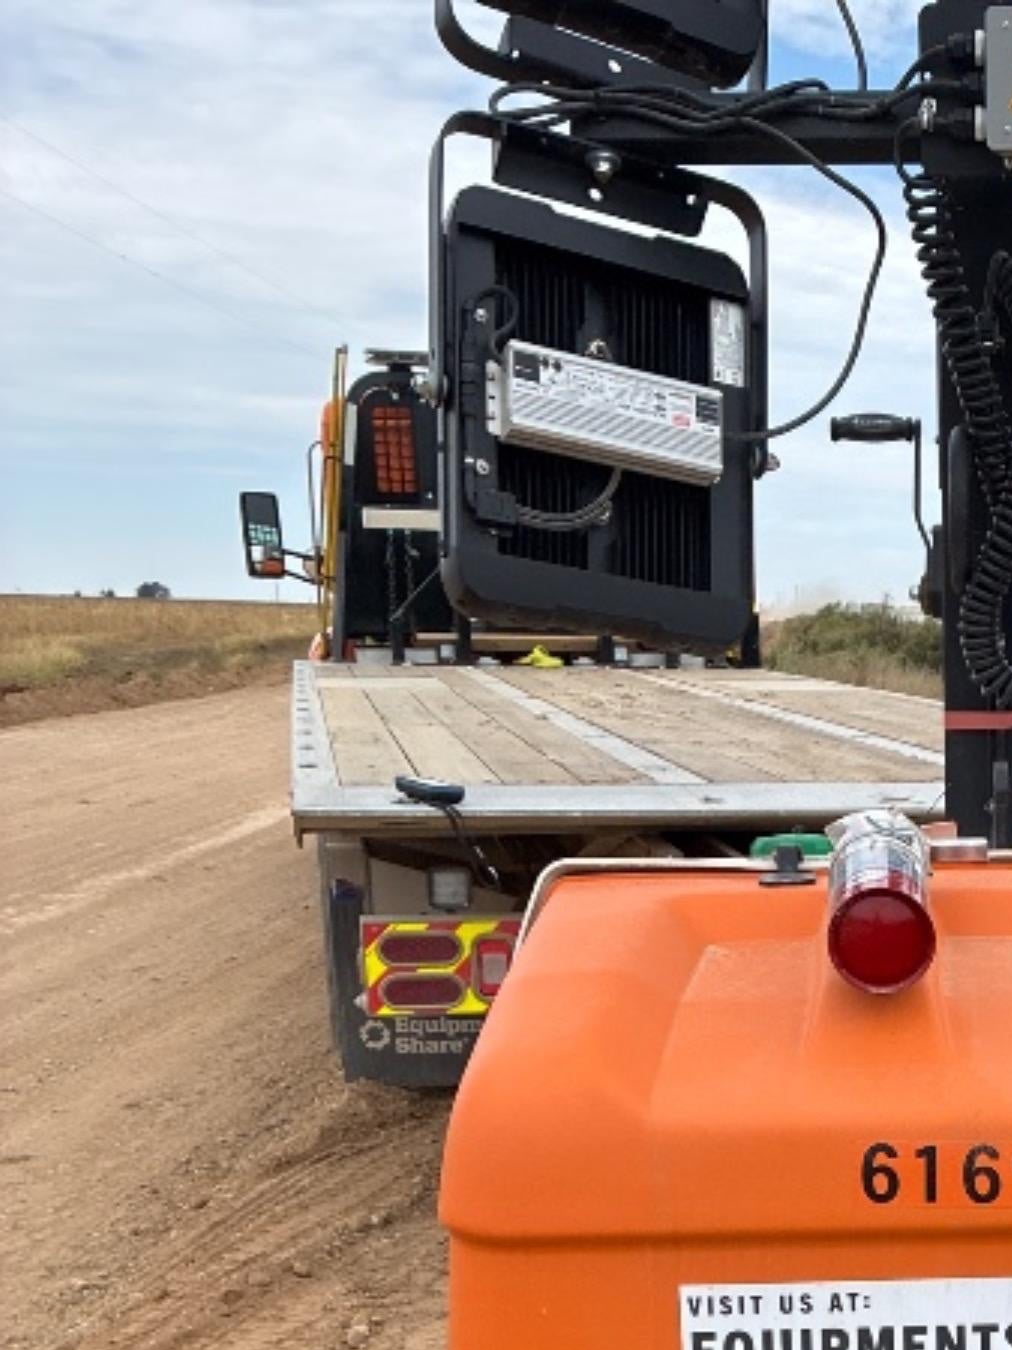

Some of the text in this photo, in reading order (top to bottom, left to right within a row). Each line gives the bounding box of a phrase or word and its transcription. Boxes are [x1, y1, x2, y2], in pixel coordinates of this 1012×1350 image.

[394, 1016, 481, 1036] Equipm
[394, 1037, 463, 1054] Share
[687, 1292, 871, 1317] VISIT US AT:
